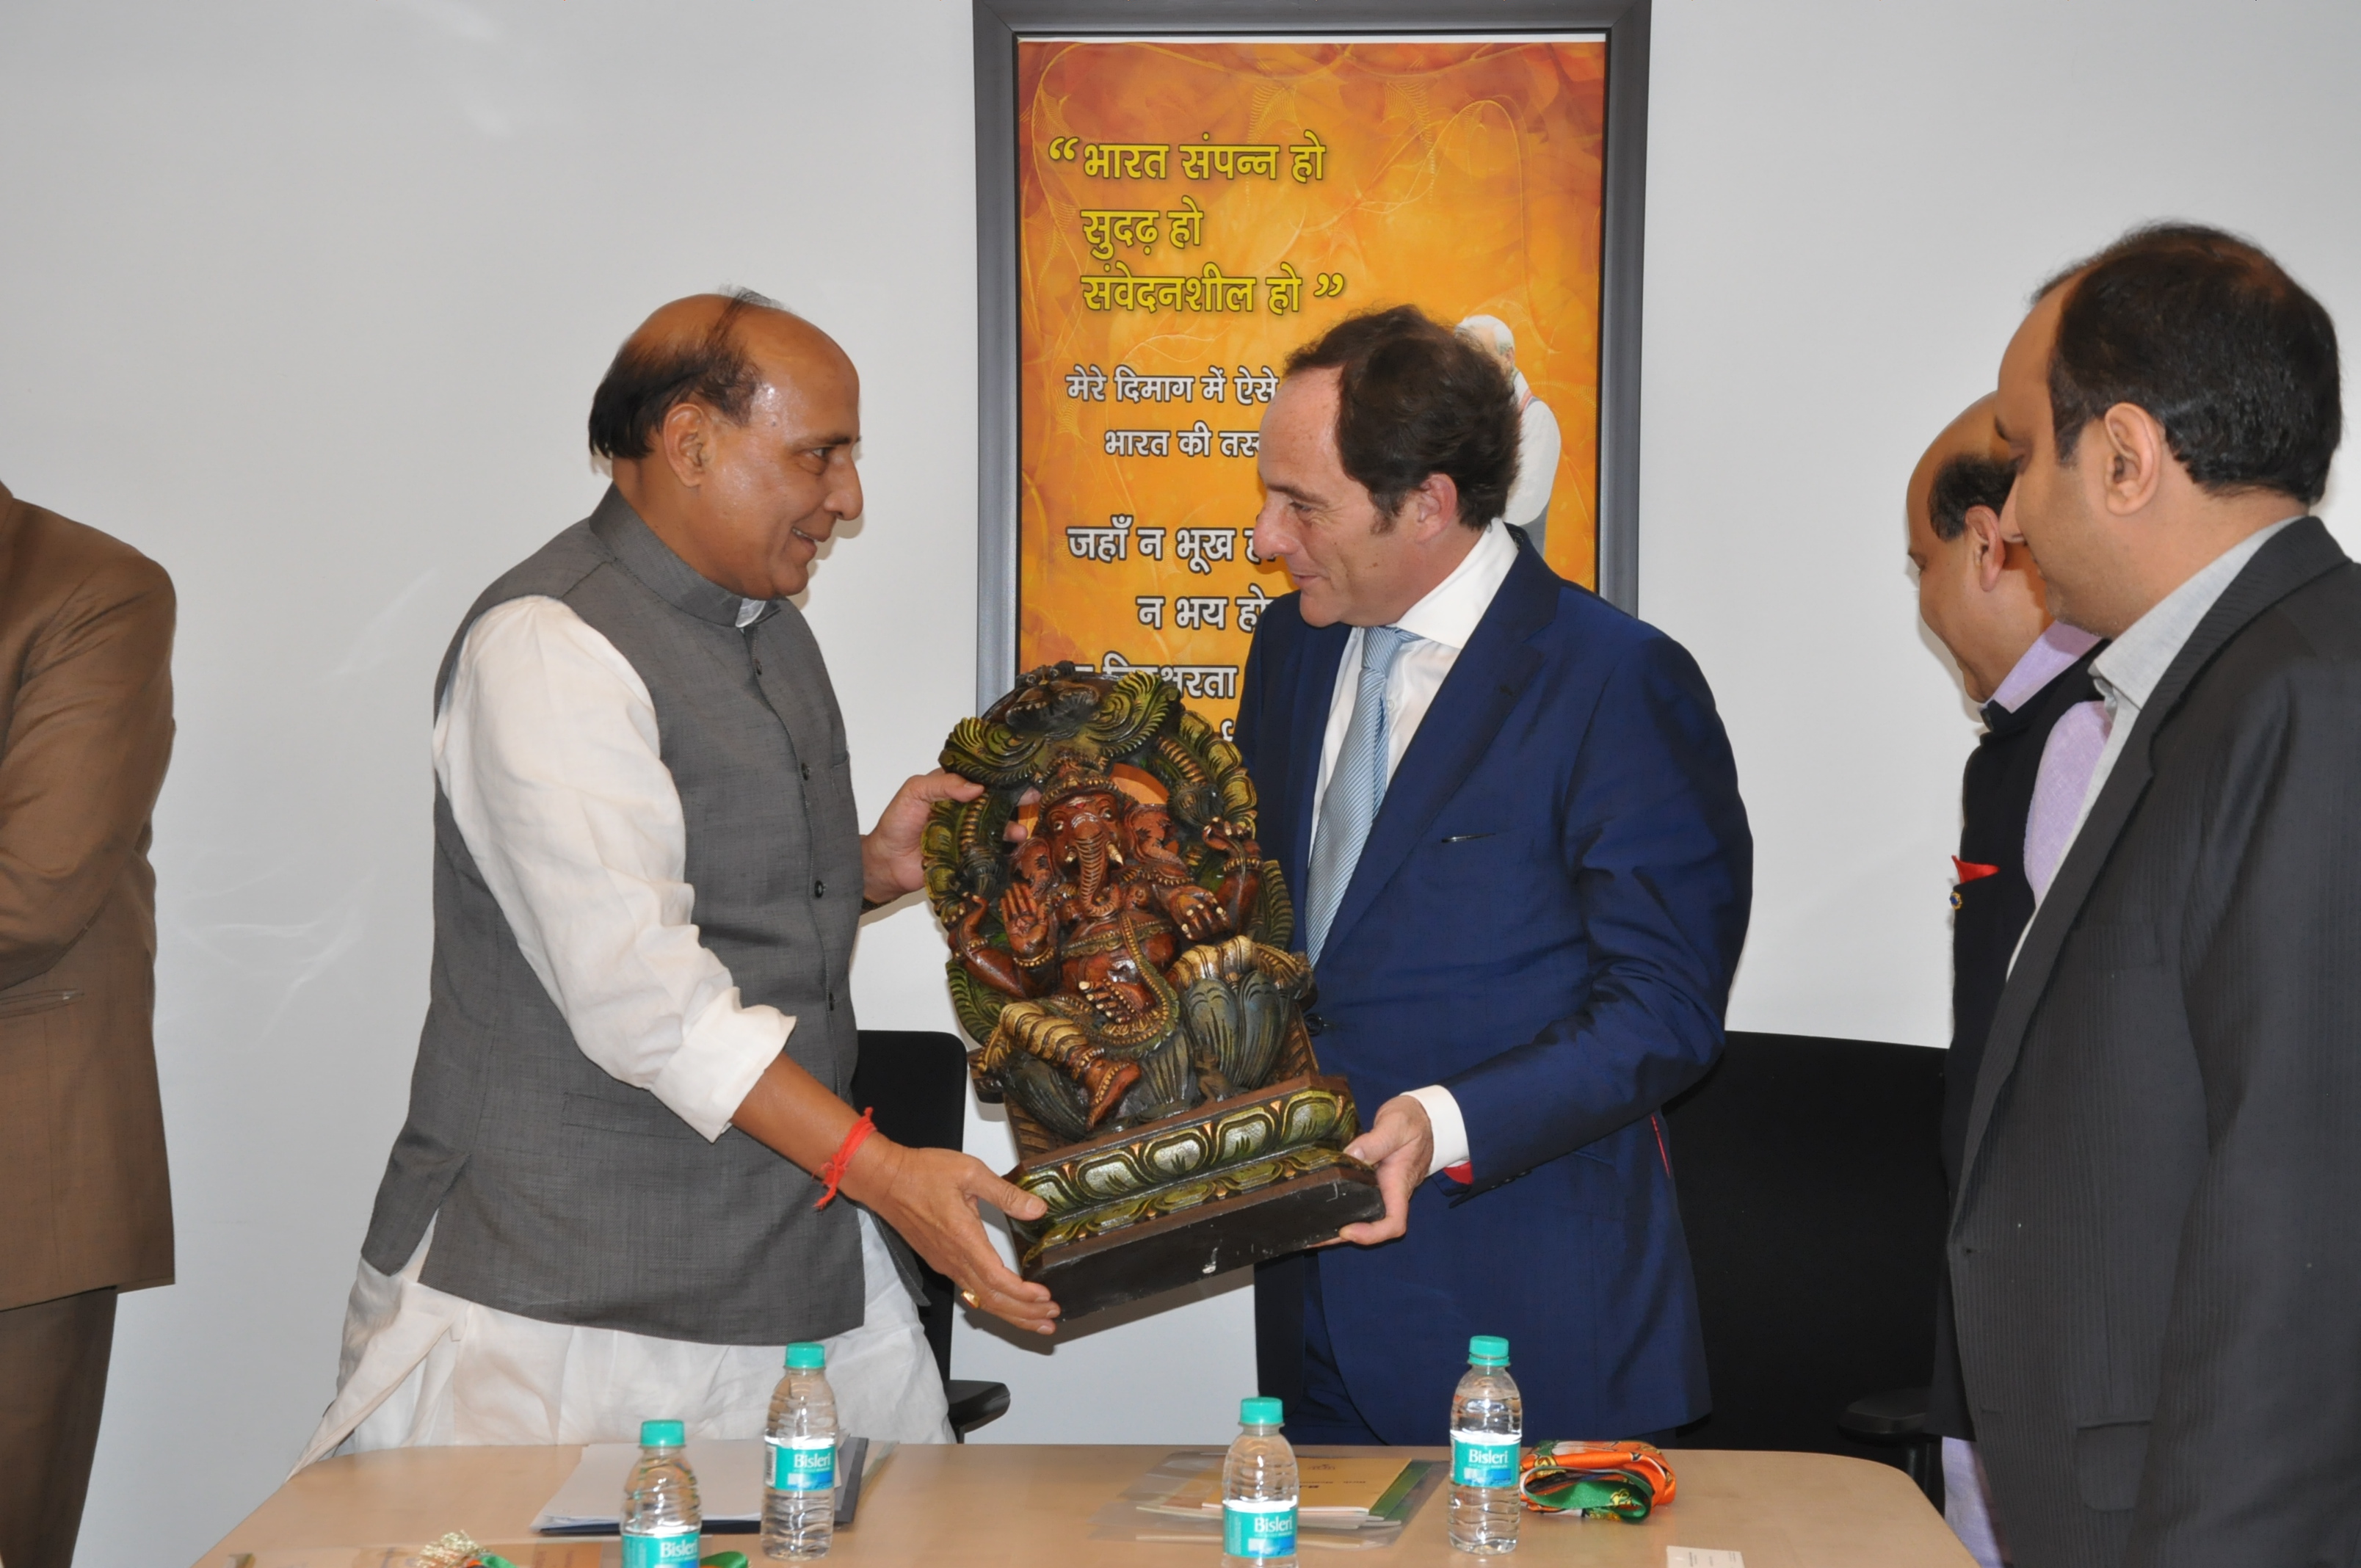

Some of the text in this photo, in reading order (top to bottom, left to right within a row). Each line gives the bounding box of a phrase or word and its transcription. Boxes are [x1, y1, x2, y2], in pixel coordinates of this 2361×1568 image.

[1179, 132, 1280, 181] संपन्न
[1289, 129, 1326, 184] हो
[1167, 195, 1203, 248] हो
[1081, 261, 1256, 313] संवेदनशील
[1065, 364, 1280, 405] मेरे दिमाग में ऐसे
[1105, 429, 1171, 457] भारत
[1178, 420, 1212, 457] की
[1067, 513, 1134, 562] जहाँ
[1137, 527, 1165, 561] न
[1175, 528, 1236, 574] भूख
[1136, 596, 1165, 631] न
[1175, 597, 1228, 631] भय
[794, 1452, 831, 1469] Bisleri
[1468, 1448, 1509, 1464] Bisleri
[1254, 1515, 1292, 1533] Bisleri
